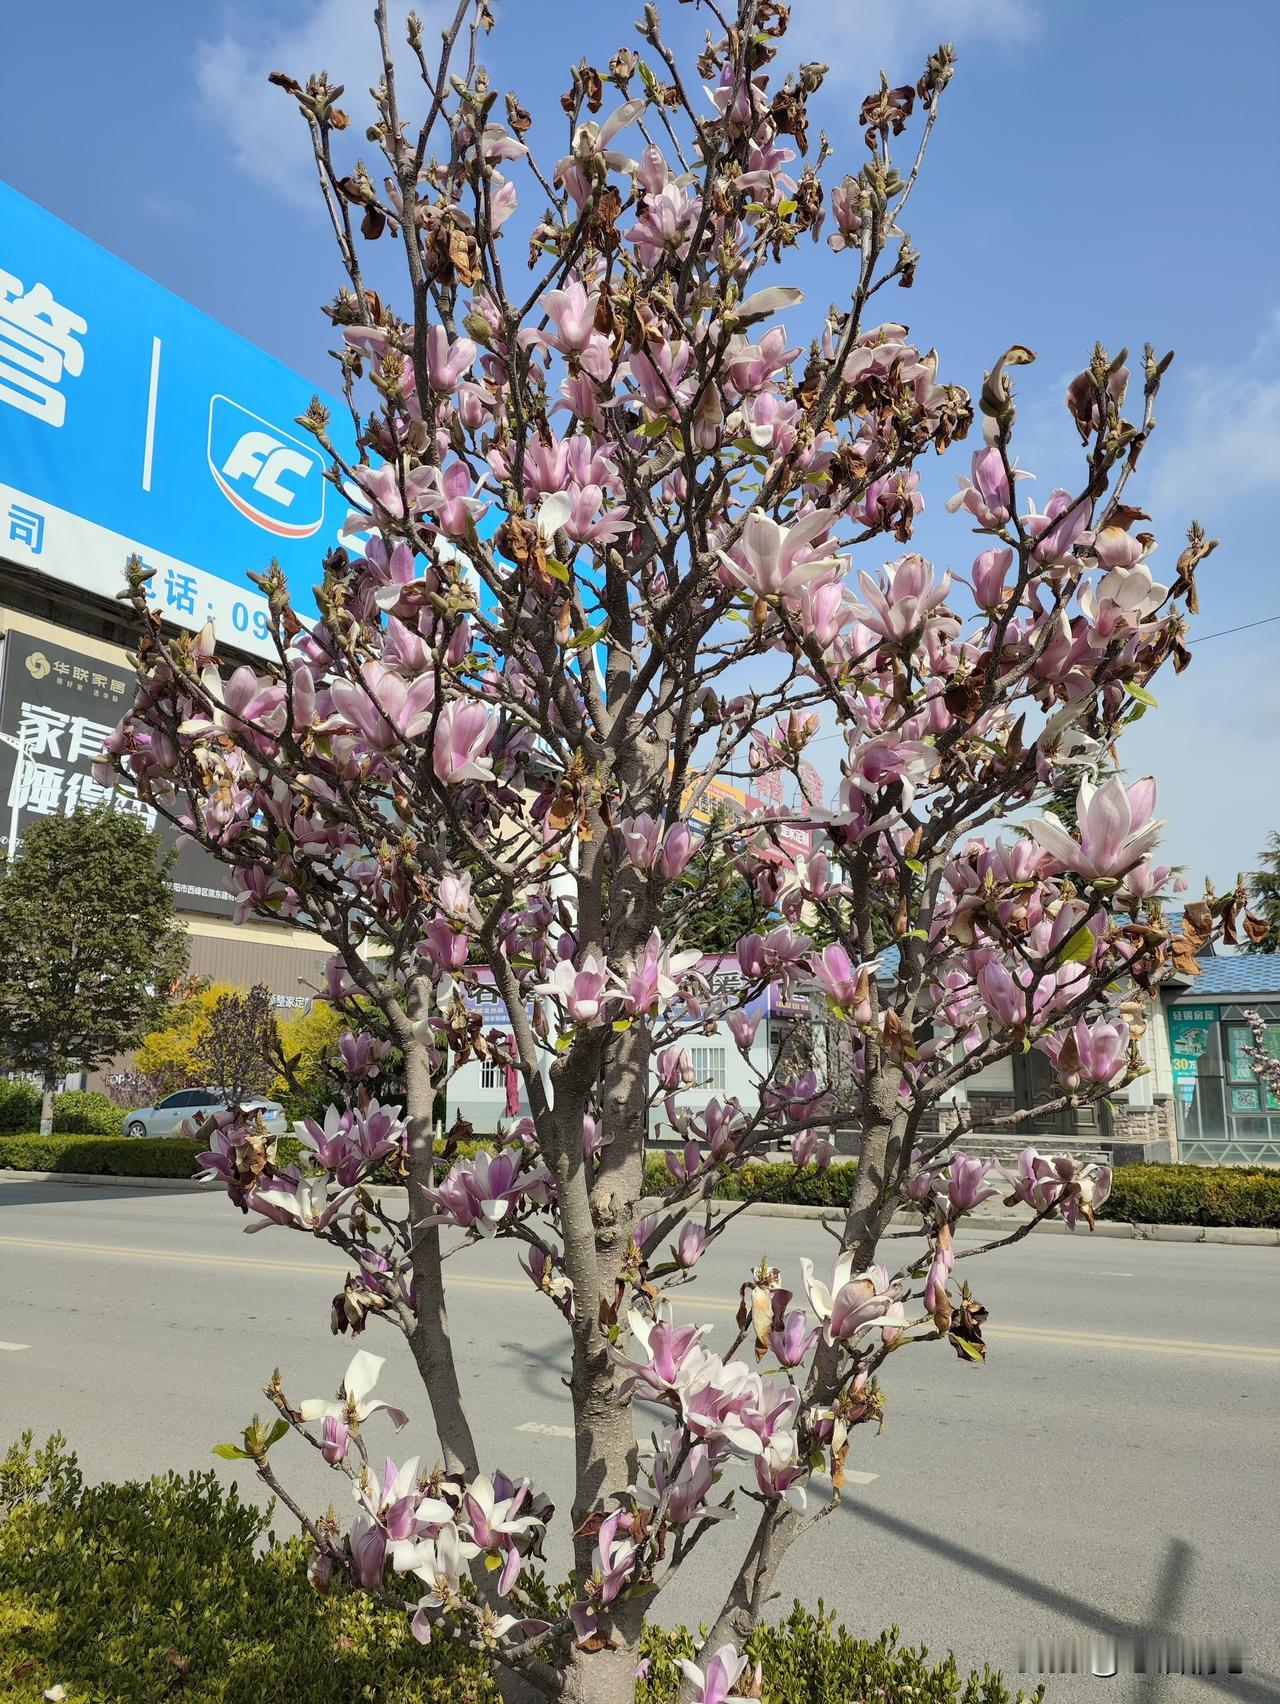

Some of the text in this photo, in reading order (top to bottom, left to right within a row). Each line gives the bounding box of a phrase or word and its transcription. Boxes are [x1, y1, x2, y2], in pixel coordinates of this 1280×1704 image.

[8, 503, 46, 555] 司
[52, 660, 126, 694] 华联家居
